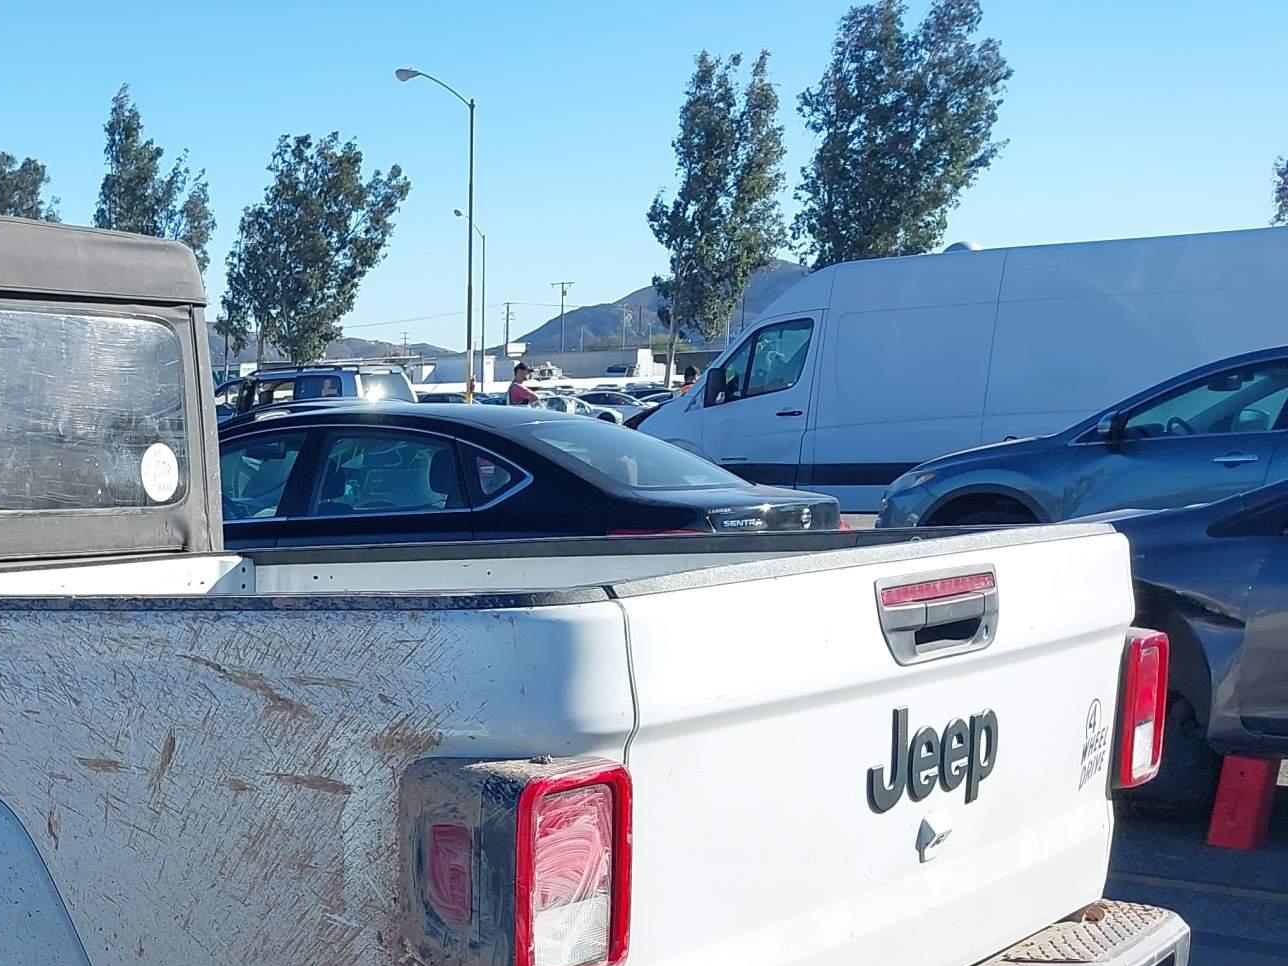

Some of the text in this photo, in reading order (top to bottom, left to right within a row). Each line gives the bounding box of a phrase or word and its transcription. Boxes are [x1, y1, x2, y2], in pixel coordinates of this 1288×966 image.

[723, 518, 763, 528] SENTRA
[1088, 703, 1098, 733] 4
[866, 705, 999, 815] Jeep
[1080, 725, 1109, 767] WHEEL
[1078, 749, 1106, 792] DRIVE
